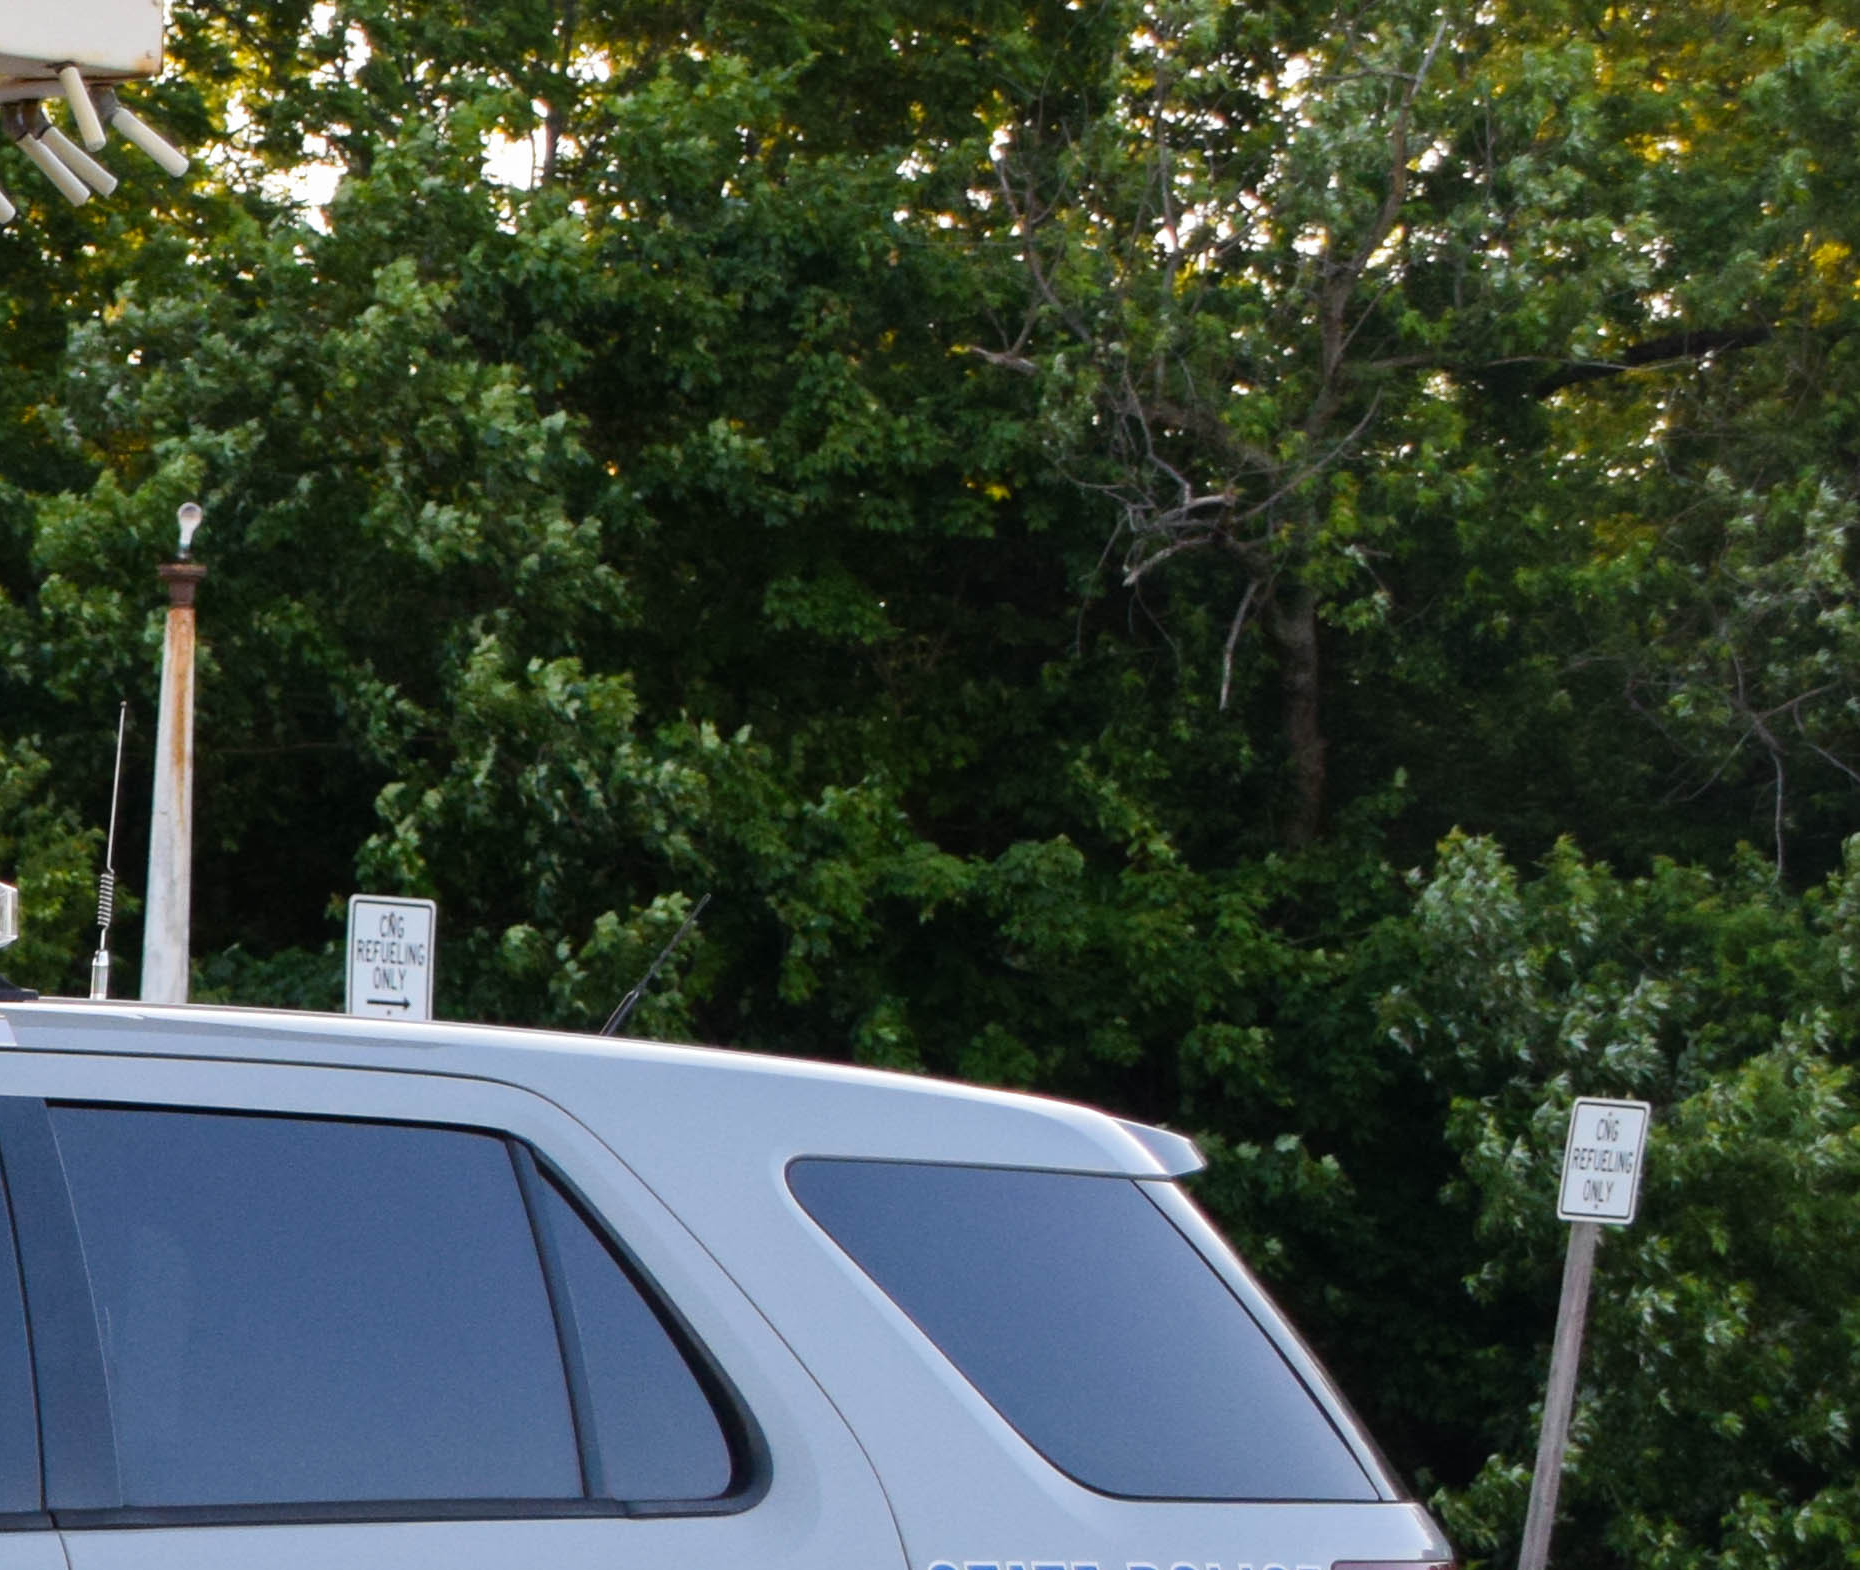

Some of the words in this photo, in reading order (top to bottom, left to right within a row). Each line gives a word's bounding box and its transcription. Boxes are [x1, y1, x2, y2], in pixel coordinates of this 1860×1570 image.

[380, 914, 405, 938] CNG
[357, 939, 426, 967] REFUELING
[373, 966, 408, 991] ONLY
[1596, 1118, 1620, 1142] CNG
[1571, 1147, 1634, 1175] REFUELING
[1582, 1179, 1615, 1202] ONLY
